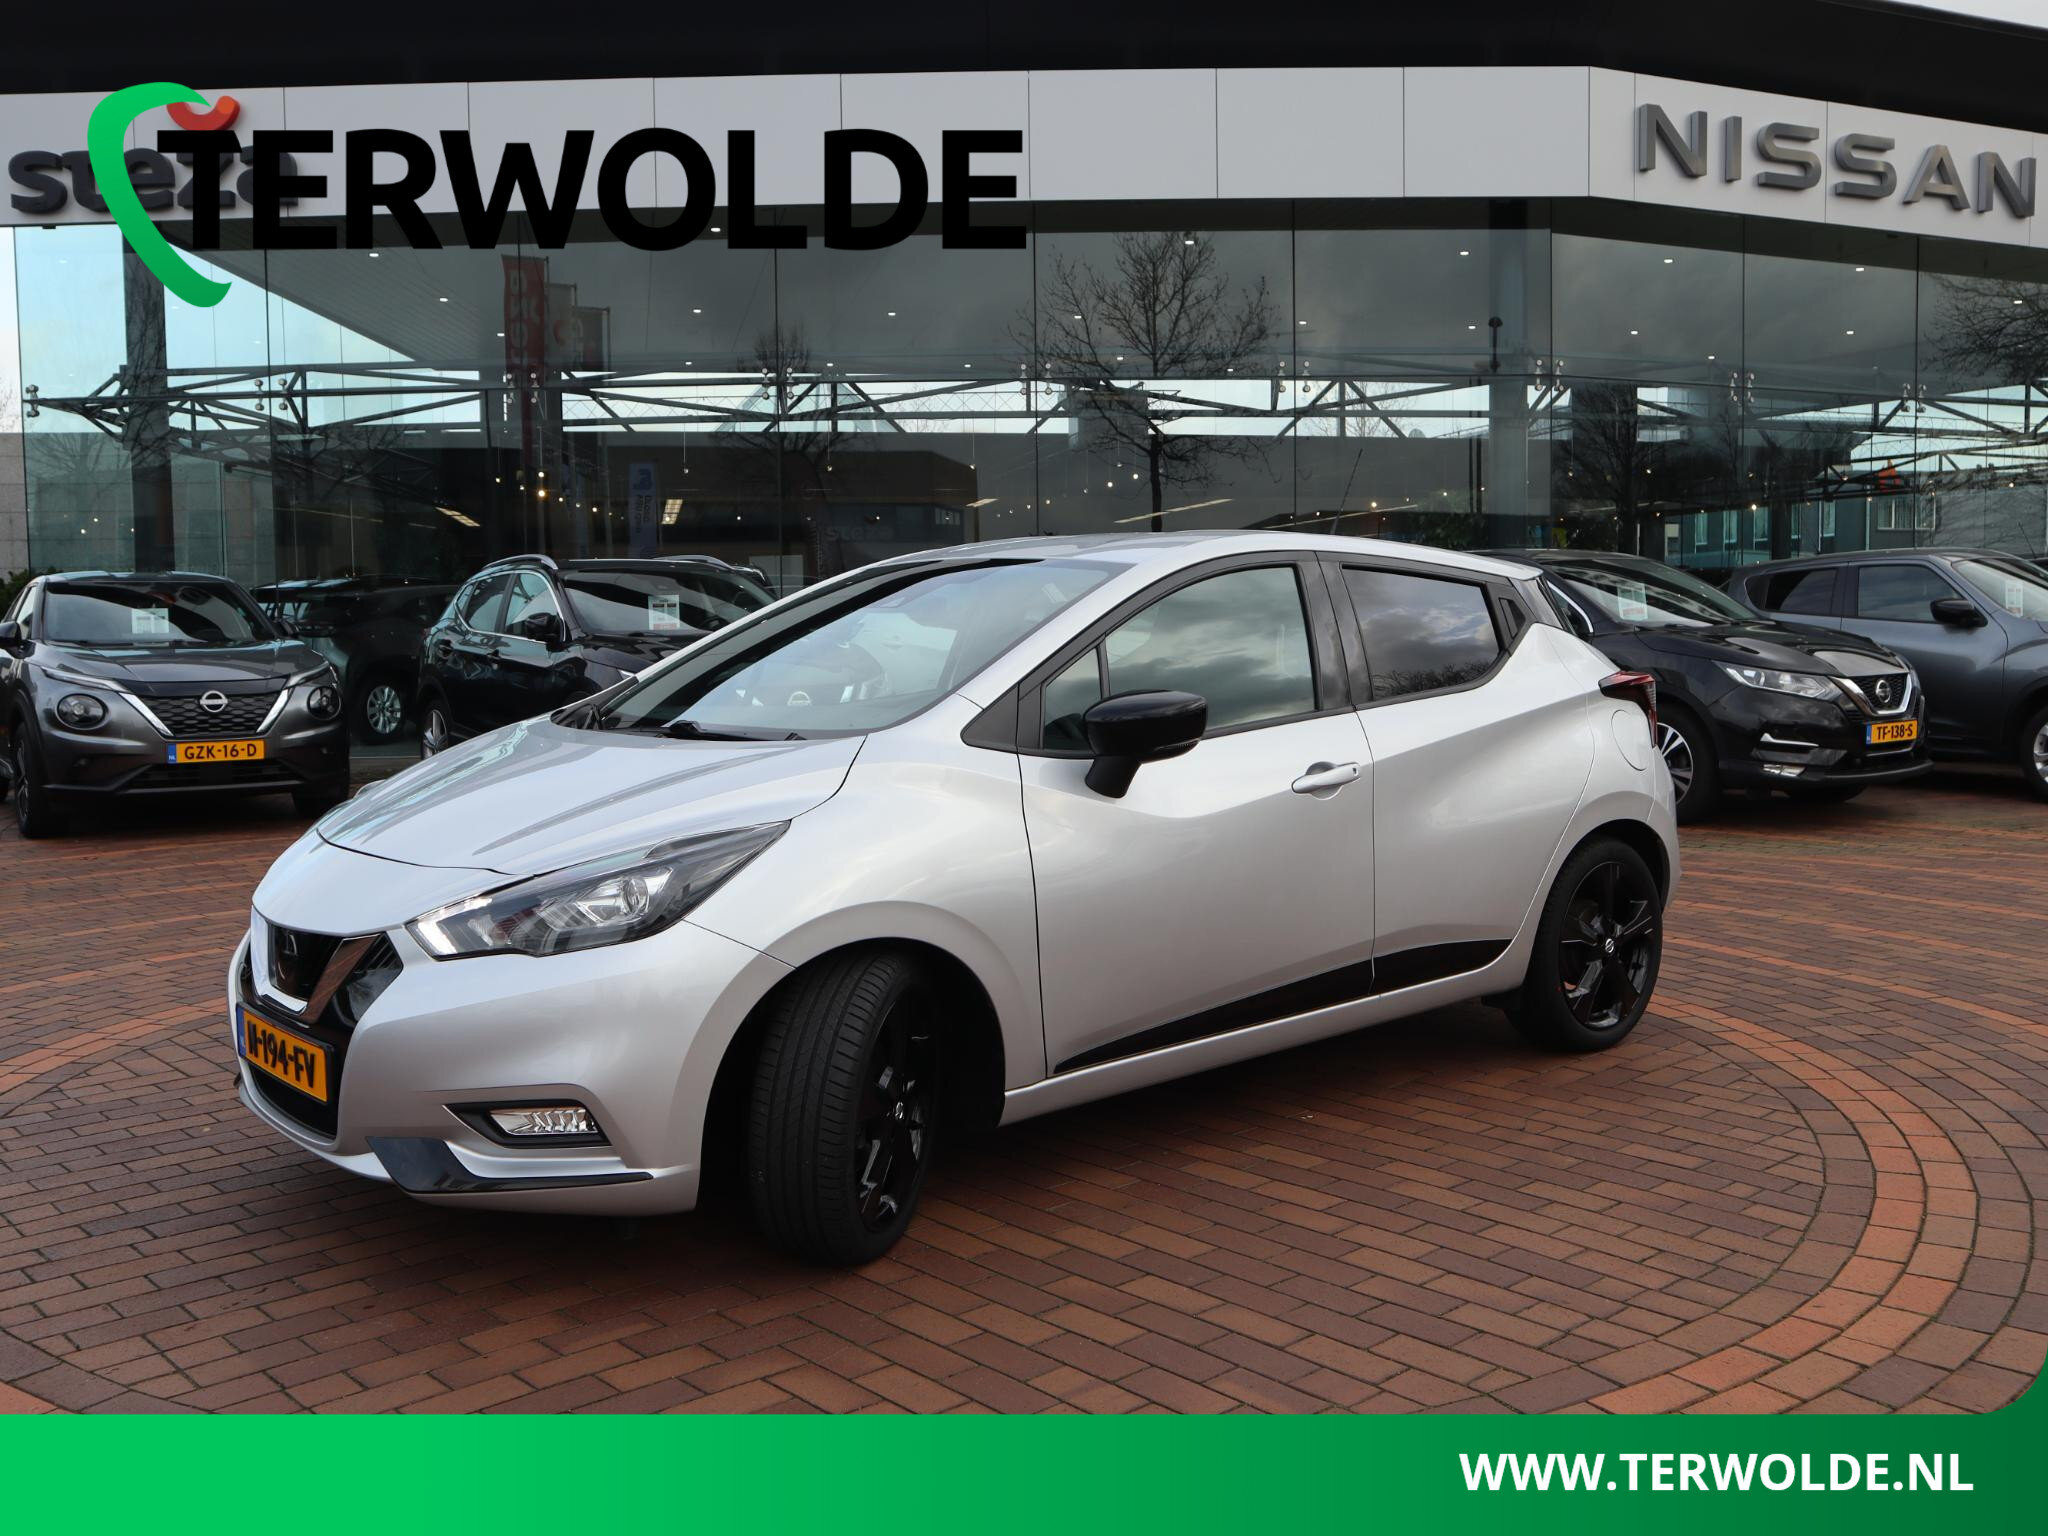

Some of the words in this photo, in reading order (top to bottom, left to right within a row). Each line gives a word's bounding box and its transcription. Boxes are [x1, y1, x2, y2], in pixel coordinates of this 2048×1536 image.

[1637, 103, 2037, 218] NISSAN
[184, 744, 257, 759] GZK-16-D
[1877, 724, 1913, 740] TF-138-S
[247, 1021, 315, 1088] N-194-FV
